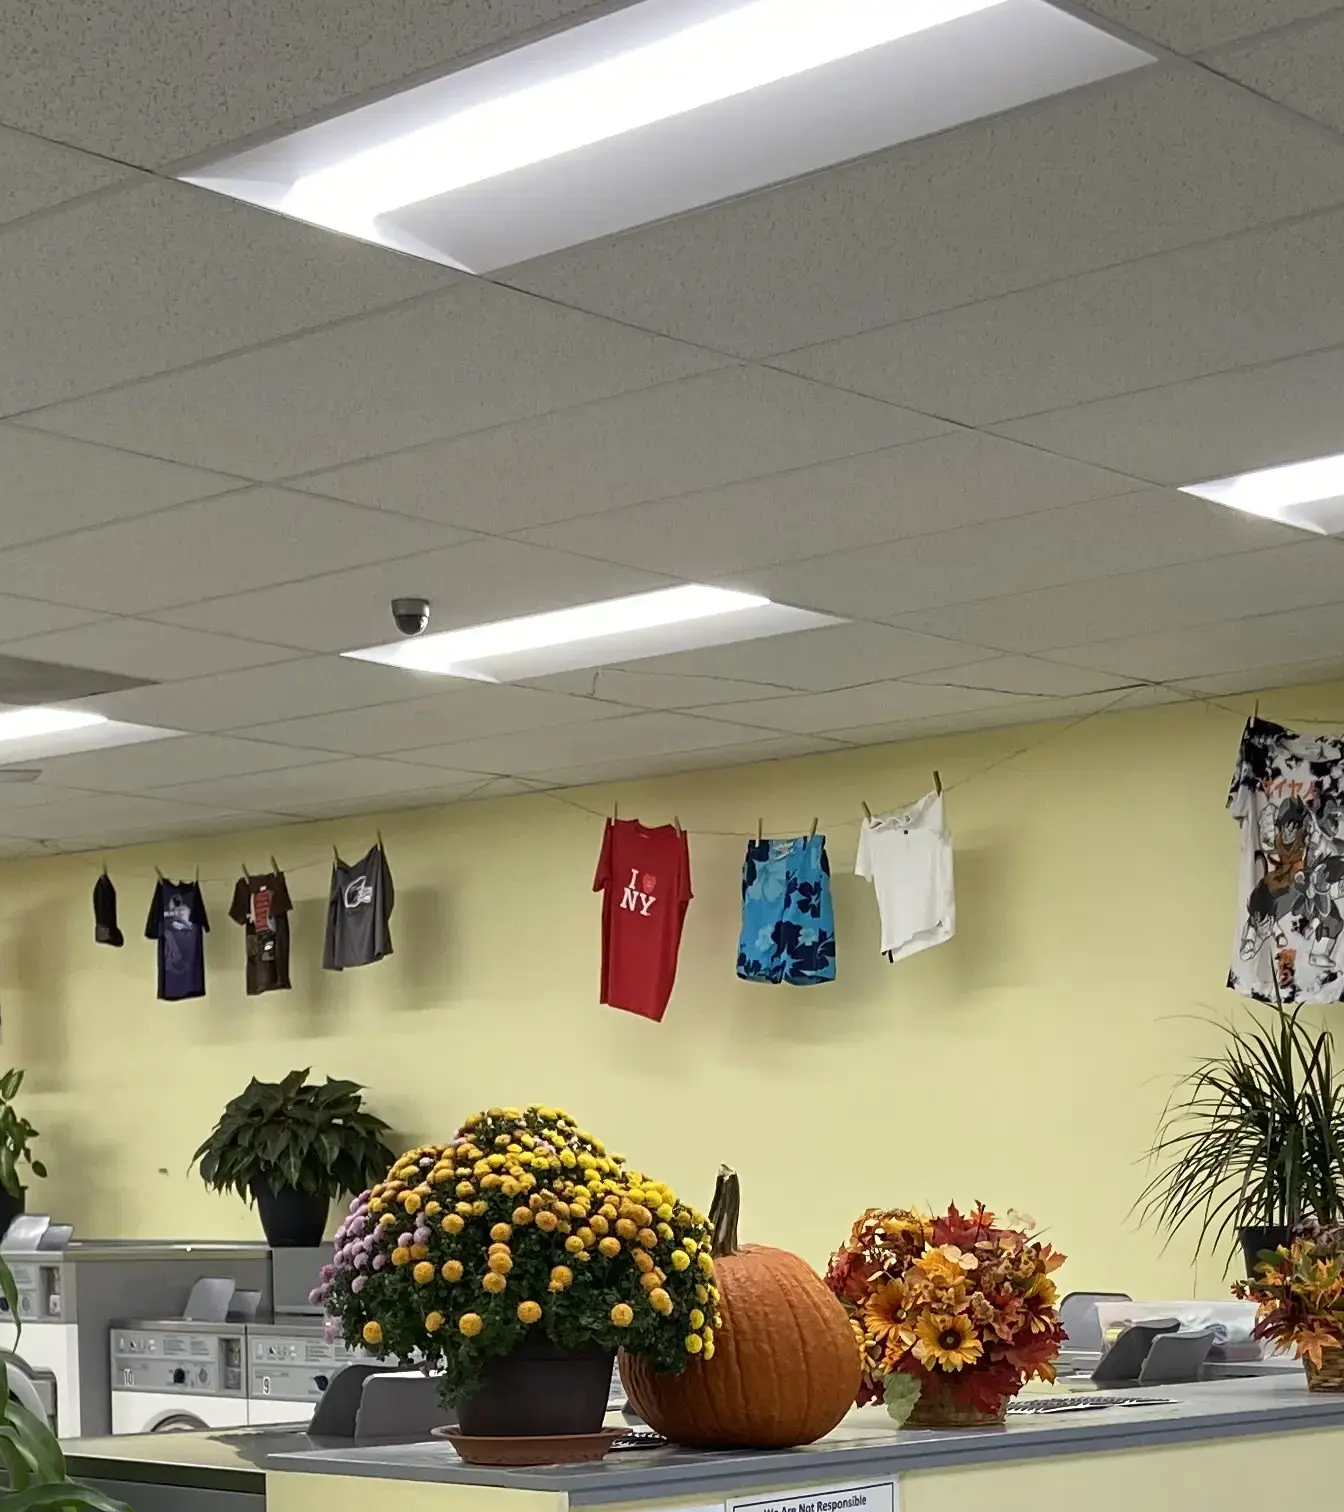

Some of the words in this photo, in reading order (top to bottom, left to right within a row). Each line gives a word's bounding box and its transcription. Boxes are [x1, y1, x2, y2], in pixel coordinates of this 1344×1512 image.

[631, 868, 639, 889] I
[620, 886, 656, 917] NY
[262, 1376, 271, 1394] 9
[817, 1494, 867, 1512] Responsible
